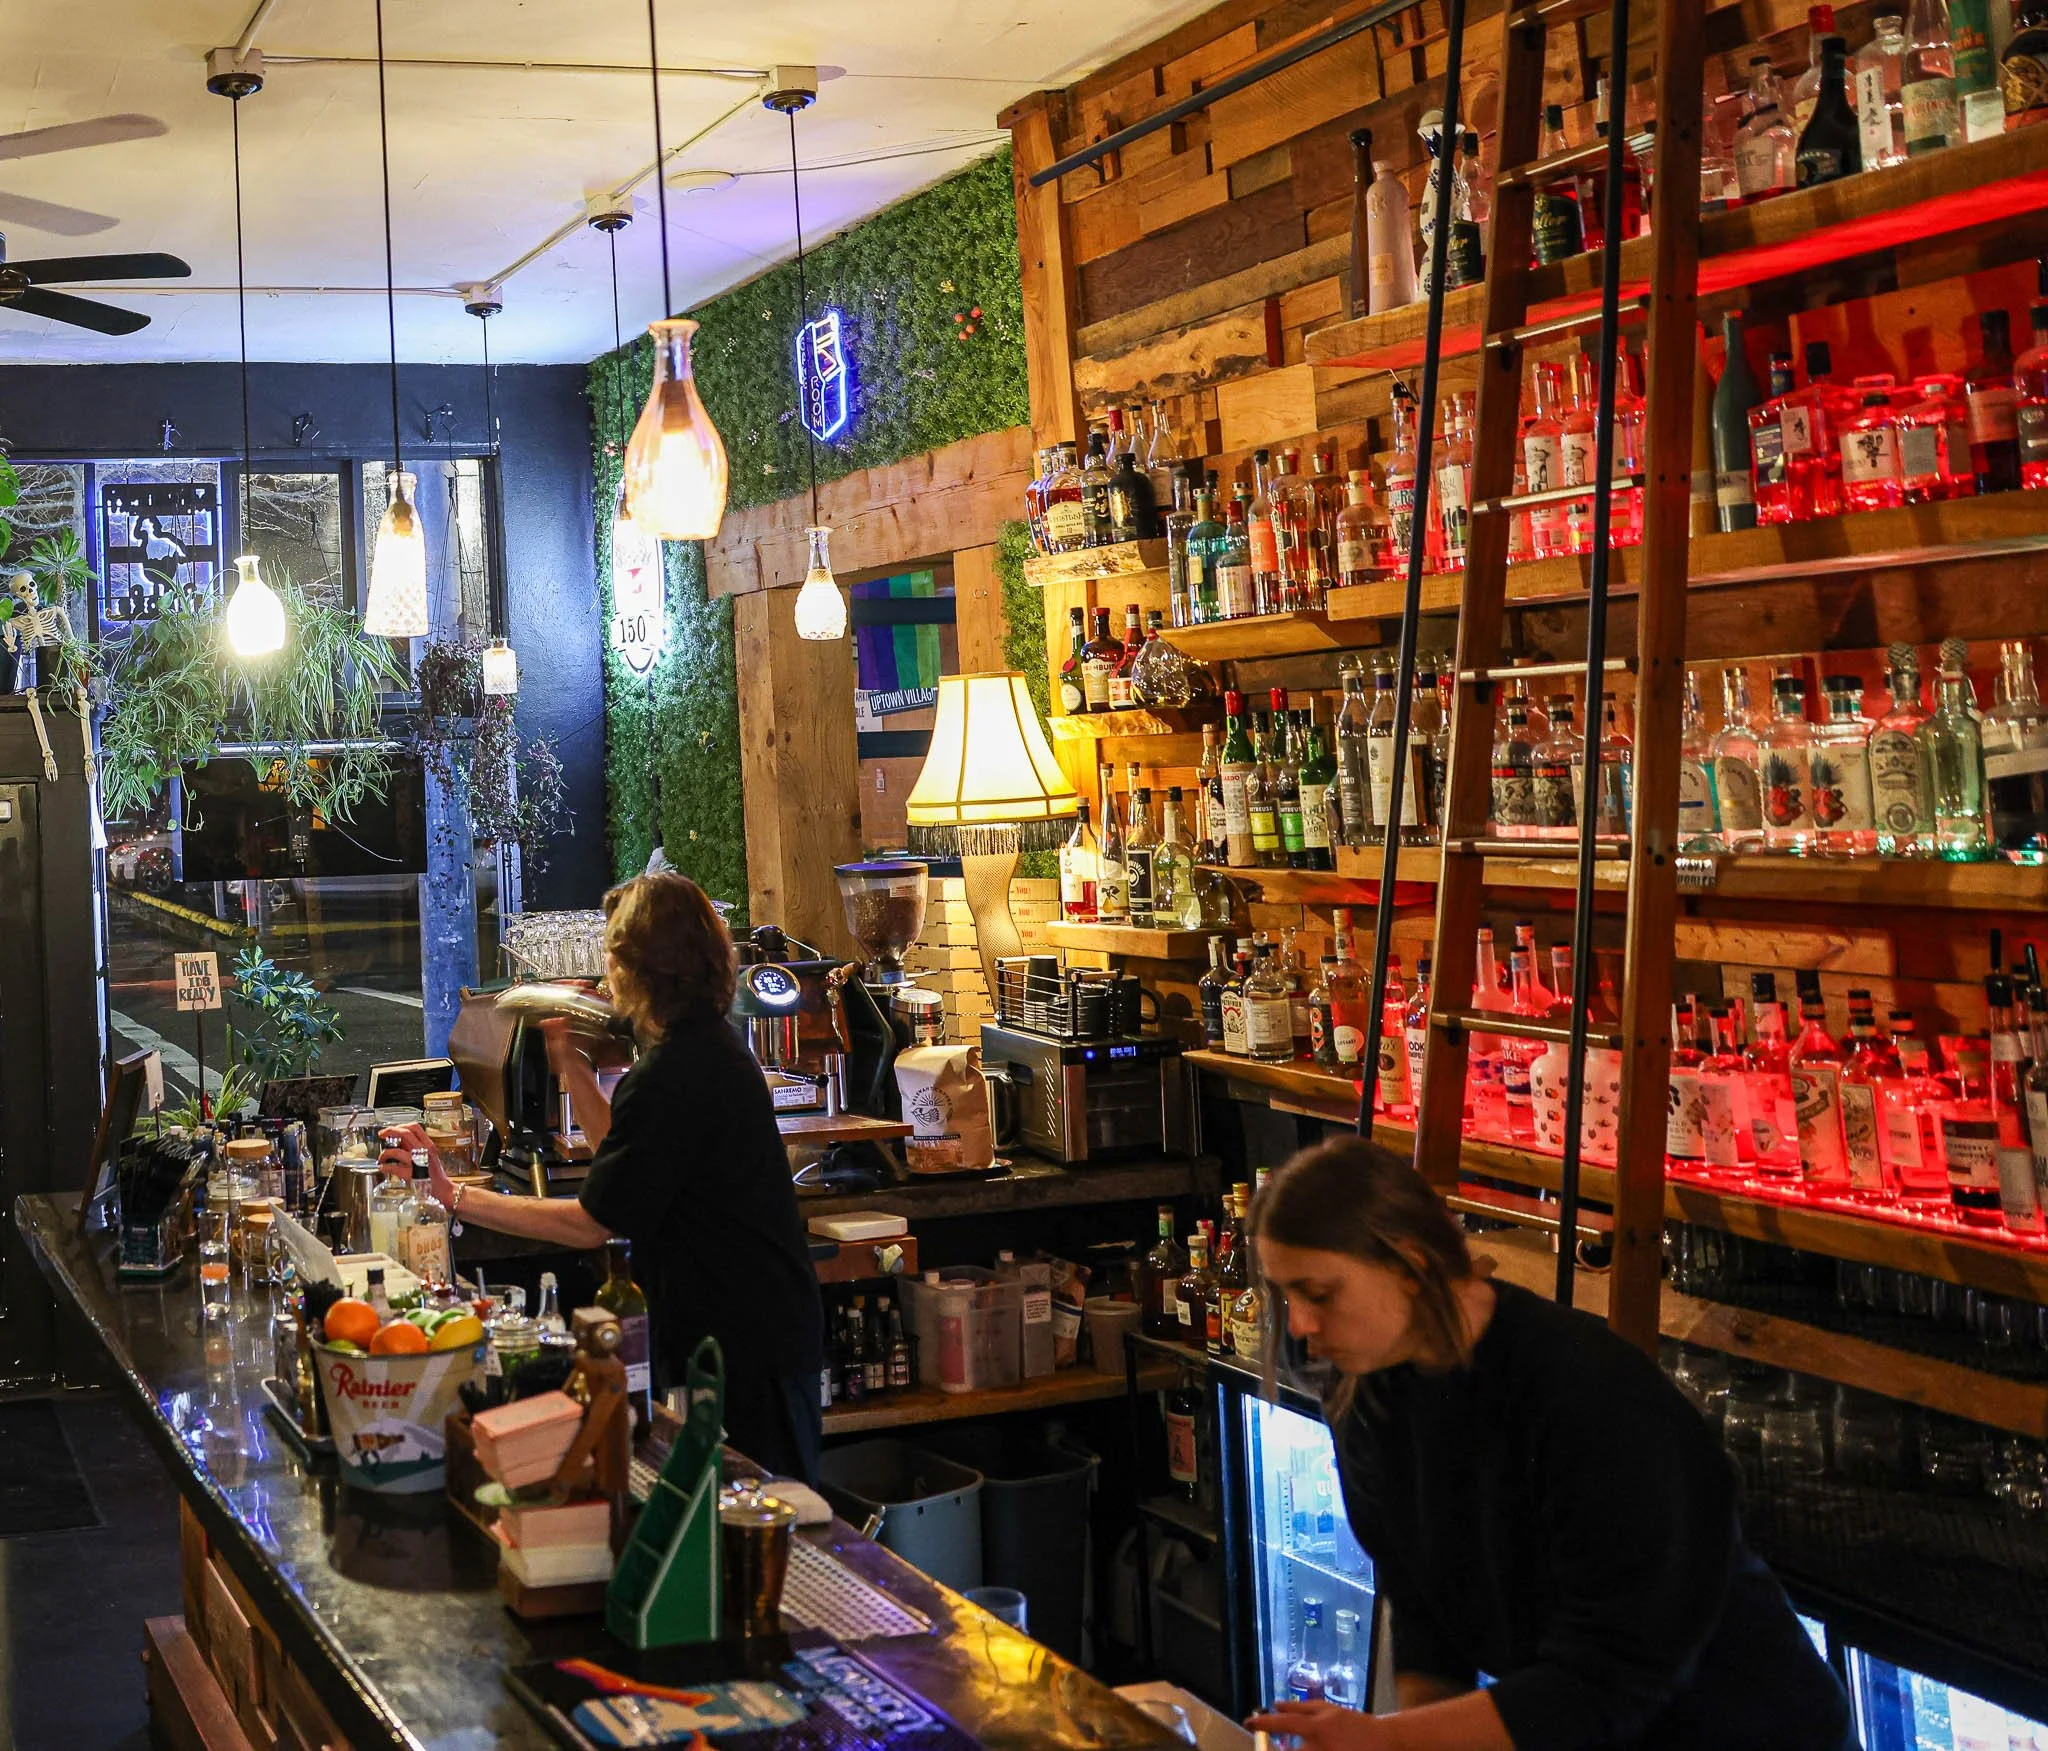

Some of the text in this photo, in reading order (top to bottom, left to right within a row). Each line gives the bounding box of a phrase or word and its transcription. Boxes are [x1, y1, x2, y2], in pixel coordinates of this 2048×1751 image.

[811, 375, 824, 429] ROOM
[620, 615, 646, 643] 150
[870, 689, 905, 711] UPTOWN
[181, 959, 213, 977] HAVE
[178, 986, 216, 1002] READY
[774, 1087, 802, 1095] SANREMO
[329, 1362, 417, 1400] Rainier
[362, 1399, 400, 1409] BEER
